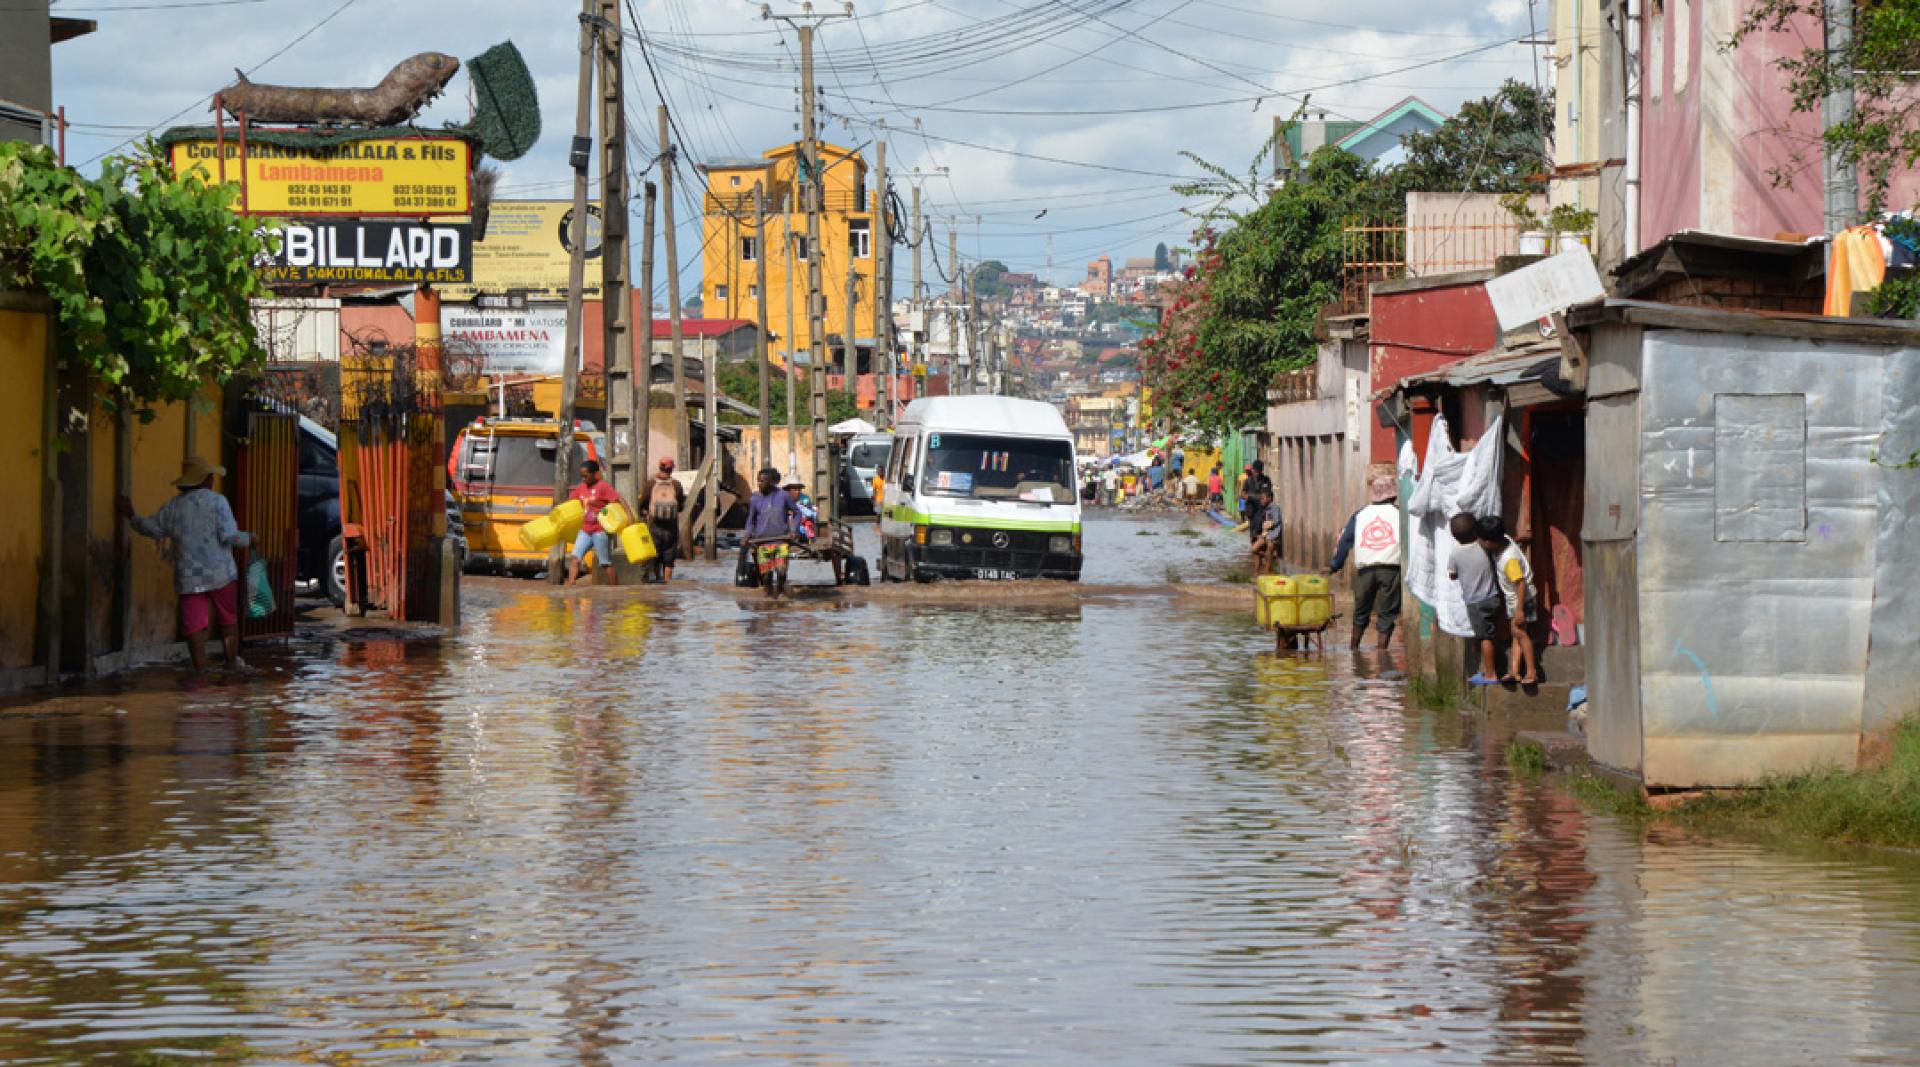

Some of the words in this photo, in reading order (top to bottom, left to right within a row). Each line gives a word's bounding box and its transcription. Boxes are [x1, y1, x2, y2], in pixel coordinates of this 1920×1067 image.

[402, 146, 417, 161] &
[421, 145, 456, 161] Fils
[259, 163, 384, 183] Lambamena
[288, 184, 306, 195] 032
[288, 196, 307, 207] 034
[254, 225, 460, 268] BILLARD
[930, 434, 940, 449] B
